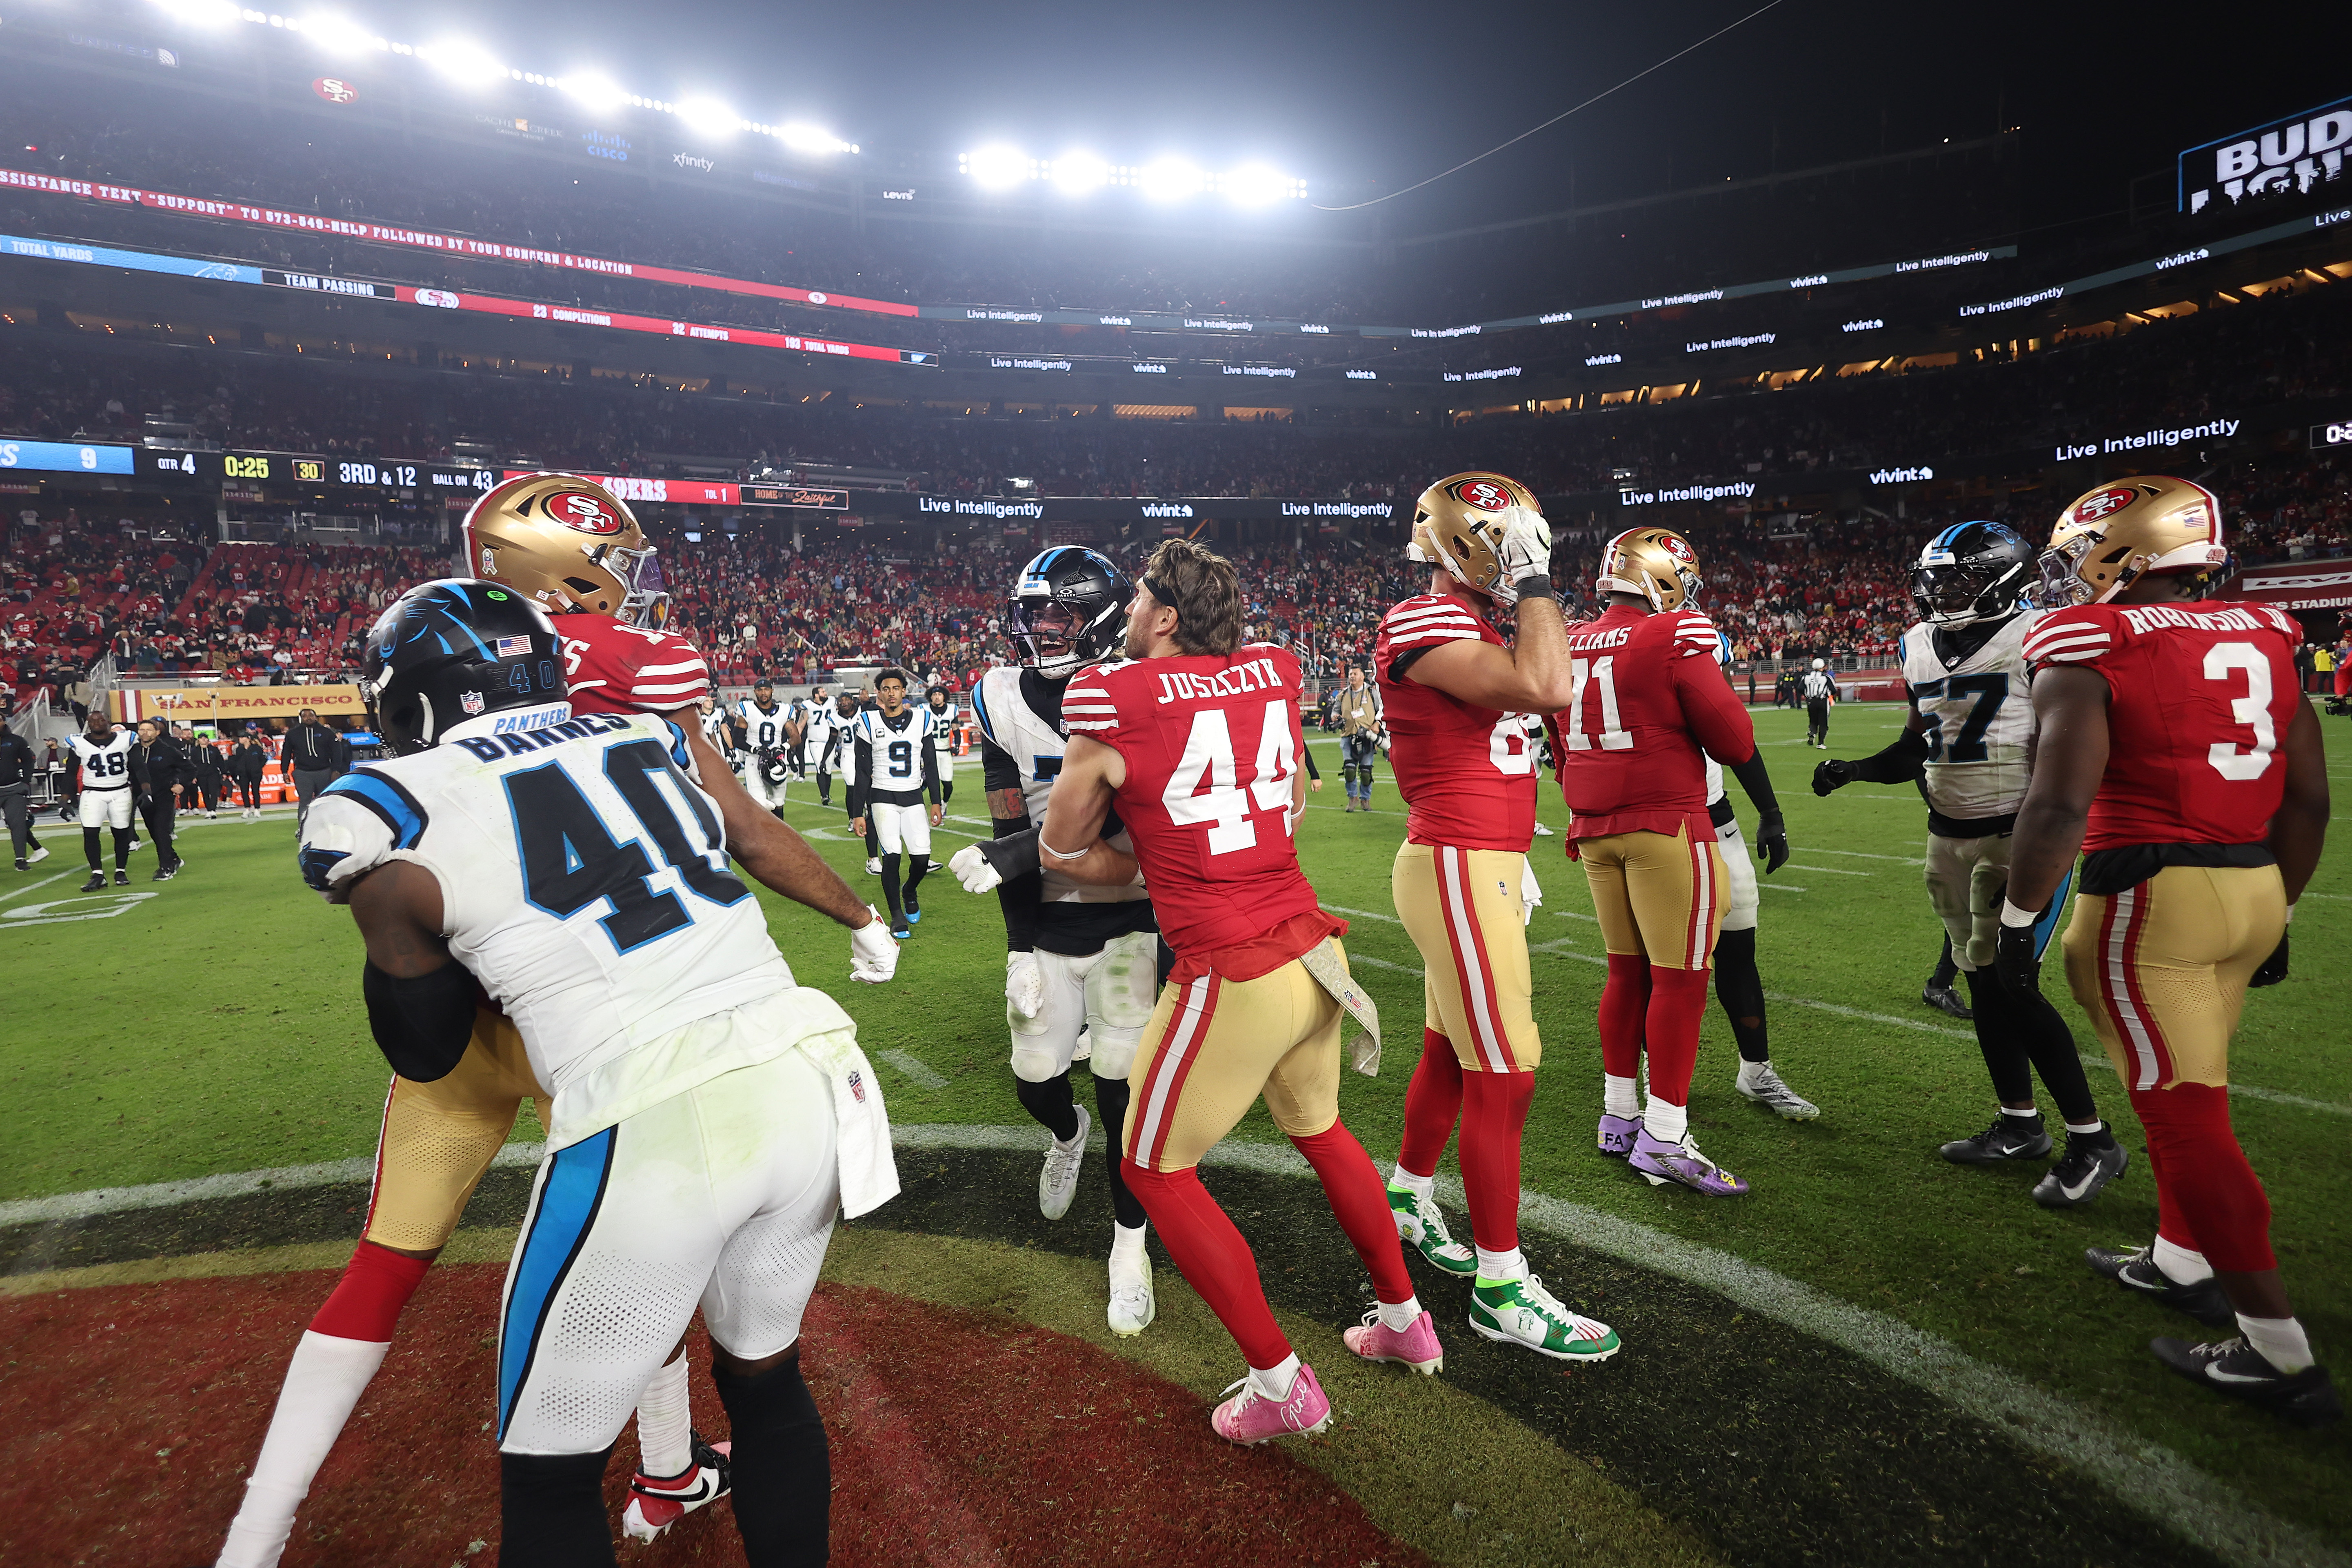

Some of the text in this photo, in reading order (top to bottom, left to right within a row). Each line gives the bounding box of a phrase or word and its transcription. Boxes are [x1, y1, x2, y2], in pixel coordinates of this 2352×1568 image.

[2217, 109, 2352, 183] BUD
[673, 152, 714, 172] xfinity
[2315, 209, 2351, 227] Live
[99, 186, 142, 202] TEXT
[240, 207, 259, 220] TO
[266, 211, 367, 236] 573-549-HELP
[373, 226, 443, 248] FOLLOWED
[448, 237, 464, 250] BY
[469, 240, 501, 257] YOUR
[505, 247, 560, 264] CONCERN
[564, 255, 573, 266] &
[577, 257, 633, 275] LOCATION
[11, 240, 93, 262] TOTAL YARDS
[1896, 251, 1990, 272] Live Intelligently
[284, 273, 375, 296] TEAM PASSING
[1642, 289, 1723, 309] Live Intelligently
[1959, 287, 2064, 317] Live Intelligently
[533, 304, 611, 326] 23 COMPLETIONS
[967, 309, 1043, 323] Live Intelligently
[1184, 319, 1253, 332] Live Intelligently
[690, 326, 729, 341] ATTEMPTS
[1411, 324, 1481, 338] Live Intelligently
[785, 336, 850, 355] 193 TOTAL YARDS
[1686, 332, 1776, 353] Live Intelligently
[991, 358, 1072, 372] Live Intelligently
[1223, 366, 1296, 378] Live Intelligently
[1444, 366, 1522, 382] Live Intelligently
[2056, 419, 2240, 461] Live Intelligently
[81, 447, 97, 469] 9
[158, 453, 196, 475] QTR 4
[224, 455, 269, 479] 0:25
[299, 462, 318, 479] 30
[339, 462, 417, 486] 3RD & 12
[432, 471, 493, 490] BALL ON 43
[601, 476, 667, 502] 49ERS
[704, 487, 727, 502] TOL 1
[754, 489, 778, 500] HOME
[1621, 481, 1756, 506] Live Intelligently
[919, 497, 1043, 519] Live Intelligently
[1282, 502, 1393, 518] Live Intelligently
[2120, 607, 2292, 635] ROBINSON JR
[1567, 627, 1632, 651] LLIAMS
[1158, 658, 1283, 704] JUSZCZYK
[160, 695, 352, 710] SAN FRANCISCO
[466, 700, 482, 712] NFL
[2203, 642, 2276, 781] 3
[494, 707, 568, 734] PANTHERS
[1912, 672, 2009, 764] 57
[87, 752, 125, 778] 48
[888, 740, 911, 777] 9
[1162, 699, 1298, 856] 44
[500, 738, 753, 956] 40
